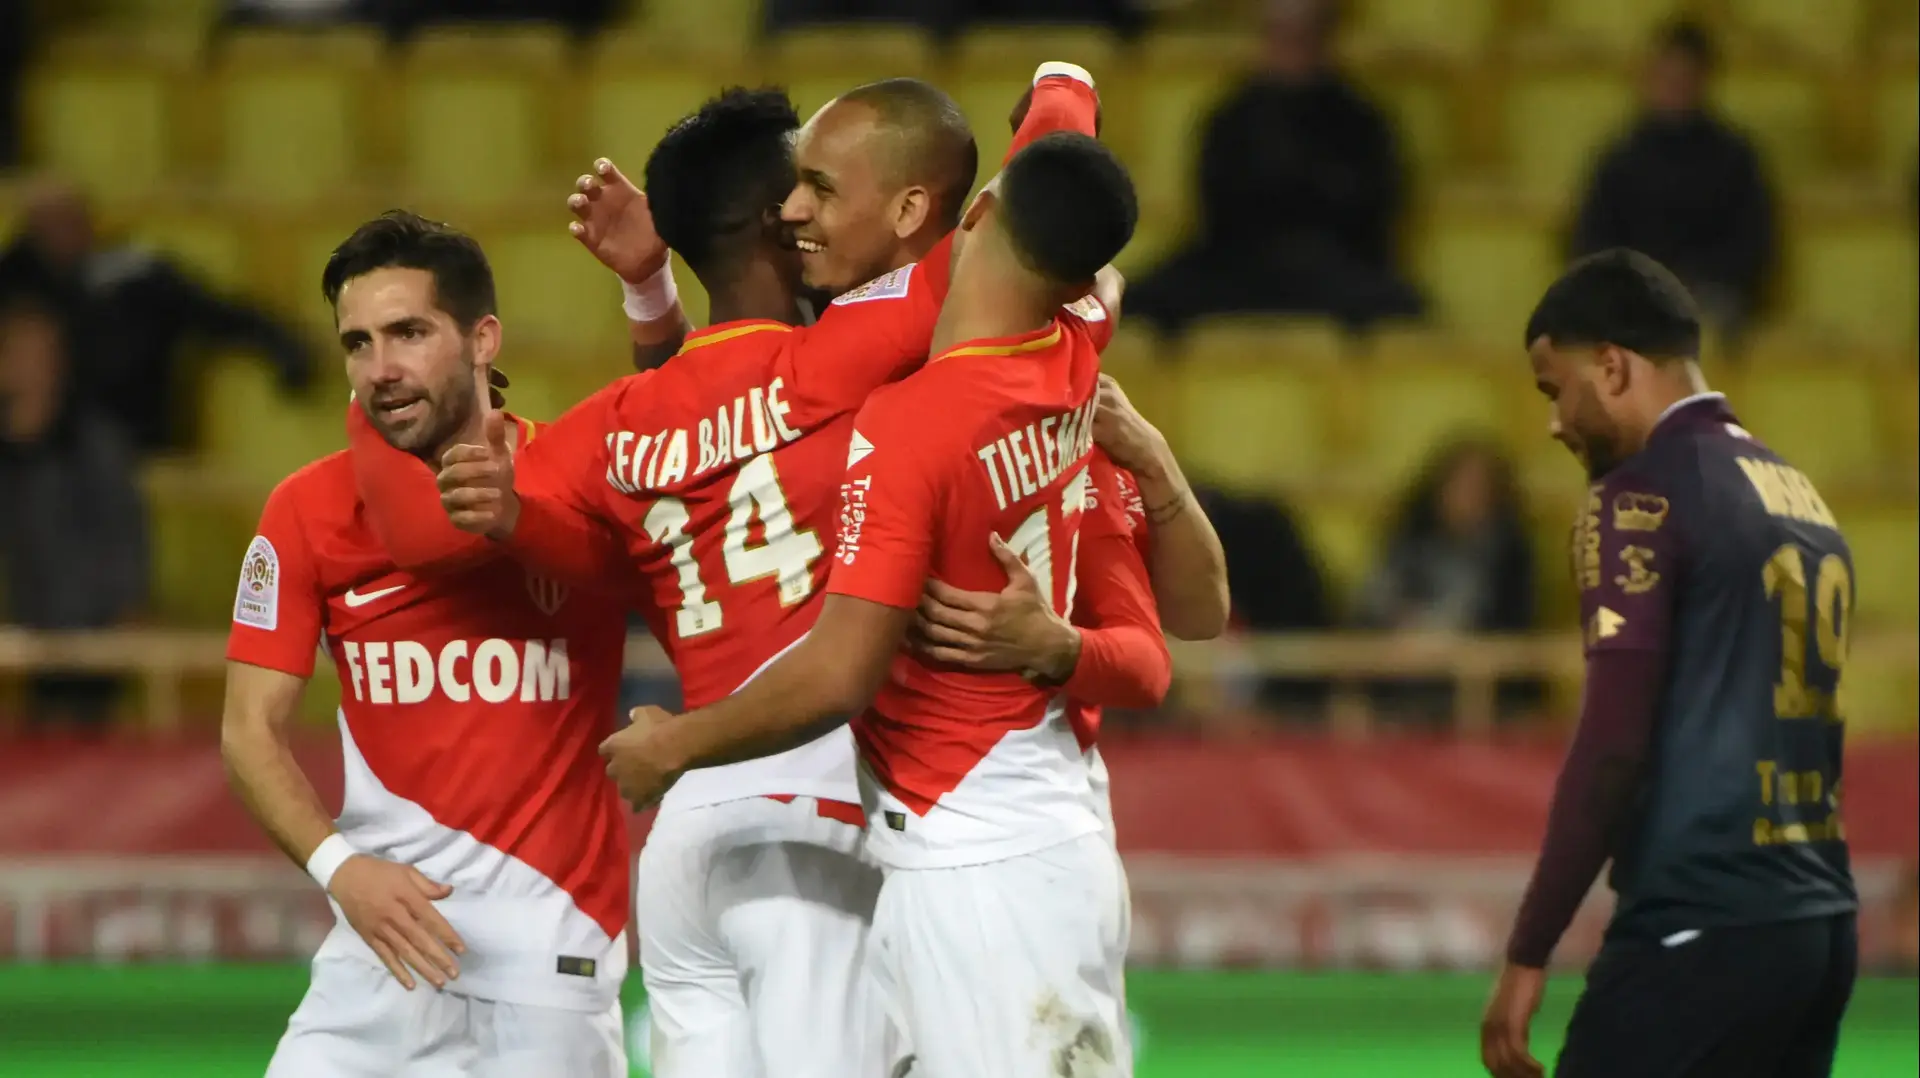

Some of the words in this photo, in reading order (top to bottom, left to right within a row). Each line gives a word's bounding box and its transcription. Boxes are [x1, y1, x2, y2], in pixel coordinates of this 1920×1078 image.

[977, 383, 1100, 511] TIELEMA
[643, 451, 824, 638] 14
[843, 474, 872, 566] Triangle
[344, 637, 570, 704] FEDCOM
